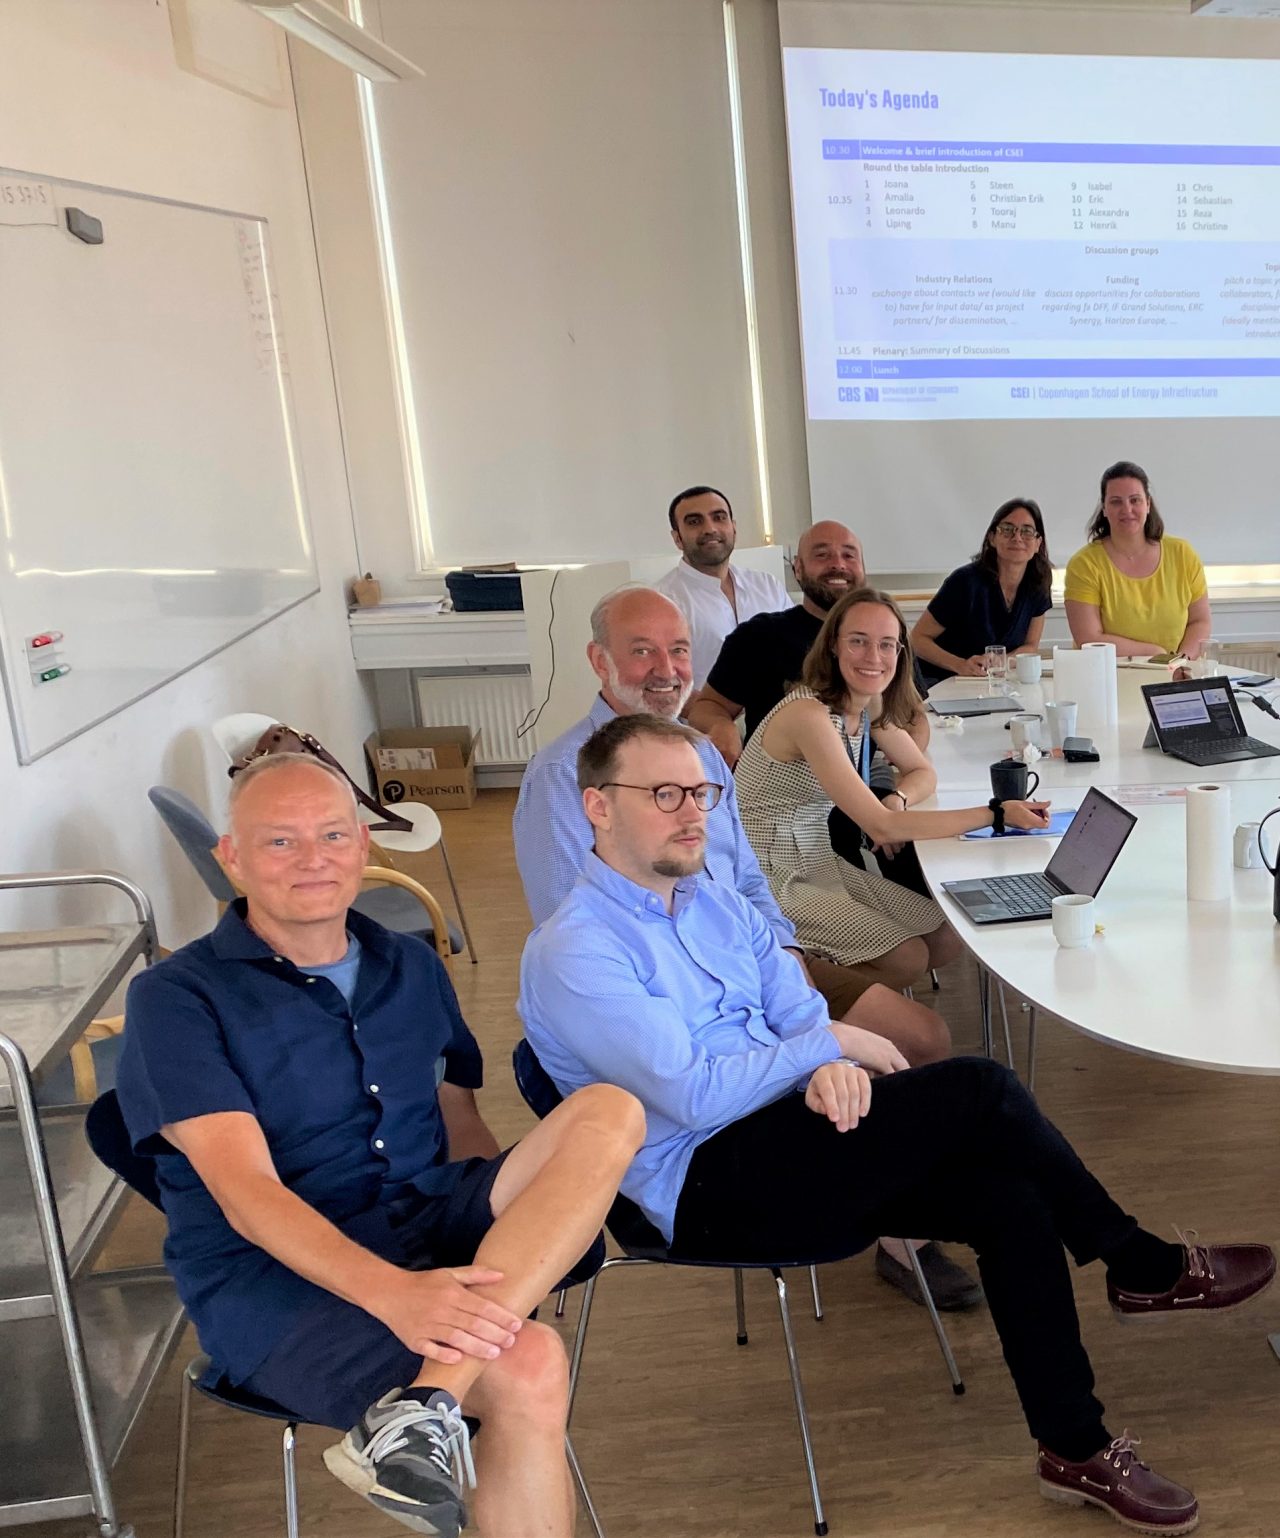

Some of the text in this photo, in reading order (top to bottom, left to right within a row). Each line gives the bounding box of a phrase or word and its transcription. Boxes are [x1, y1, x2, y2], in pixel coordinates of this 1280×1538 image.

[819, 88, 939, 111] Today's Agenda
[863, 146, 1024, 157] Welcome & brief introduction of CSEI
[863, 163, 989, 173] Round the table introduction
[989, 181, 1014, 190] Steen
[1088, 182, 1113, 191] Isabel
[1193, 183, 1213, 192] Chris
[884, 193, 914, 202] Amalia
[989, 194, 1027, 203] Christian
[1028, 194, 1044, 203] Erik
[1072, 195, 1104, 203] 10 Eric
[1193, 196, 1233, 205] Sebastian
[885, 207, 925, 215] Leonardo
[991, 207, 1016, 218] Tooraj
[1089, 209, 1129, 217] Alexandra
[886, 220, 911, 230] Liping
[991, 221, 1016, 229] Manu
[1090, 221, 1117, 230] Henrik
[1176, 222, 1228, 231] 16 Christine
[1085, 246, 1159, 257] Discussion groups
[916, 275, 993, 285] Industry Relations
[1106, 276, 1139, 285] Funding
[1224, 276, 1244, 285] pitch
[1253, 277, 1272, 285] topic
[872, 288, 911, 299] exchange
[914, 288, 938, 297] about
[940, 289, 975, 297] contacts
[991, 288, 1020, 298] (would
[1022, 289, 1036, 297] like
[1045, 288, 1200, 299] discuss opportunities for collaborations
[884, 302, 897, 312] to)
[899, 302, 919, 311] have
[921, 302, 934, 312] for
[936, 303, 958, 312] input
[959, 302, 982, 312] data/
[995, 303, 1024, 313] project
[1042, 302, 1081, 313] regarding
[1121, 303, 1146, 311] Grand
[1148, 303, 1186, 313] Solutions,
[892, 315, 934, 326] partners/
[934, 315, 948, 326] for
[949, 315, 1008, 325] dissemination,
[1069, 316, 1102, 326] Synergy,
[1105, 316, 1136, 325] Horizon
[1137, 316, 1167, 326] Europe,
[1222, 316, 1251, 326] (ideally
[873, 346, 1010, 356] Plenary: Summary of Discussions
[873, 365, 899, 374] Lunch
[838, 387, 861, 402] CBS
[1011, 386, 1218, 399] CSEI Copenhagen School of Energy Infrastructure
[409, 785, 464, 796] Pearson
